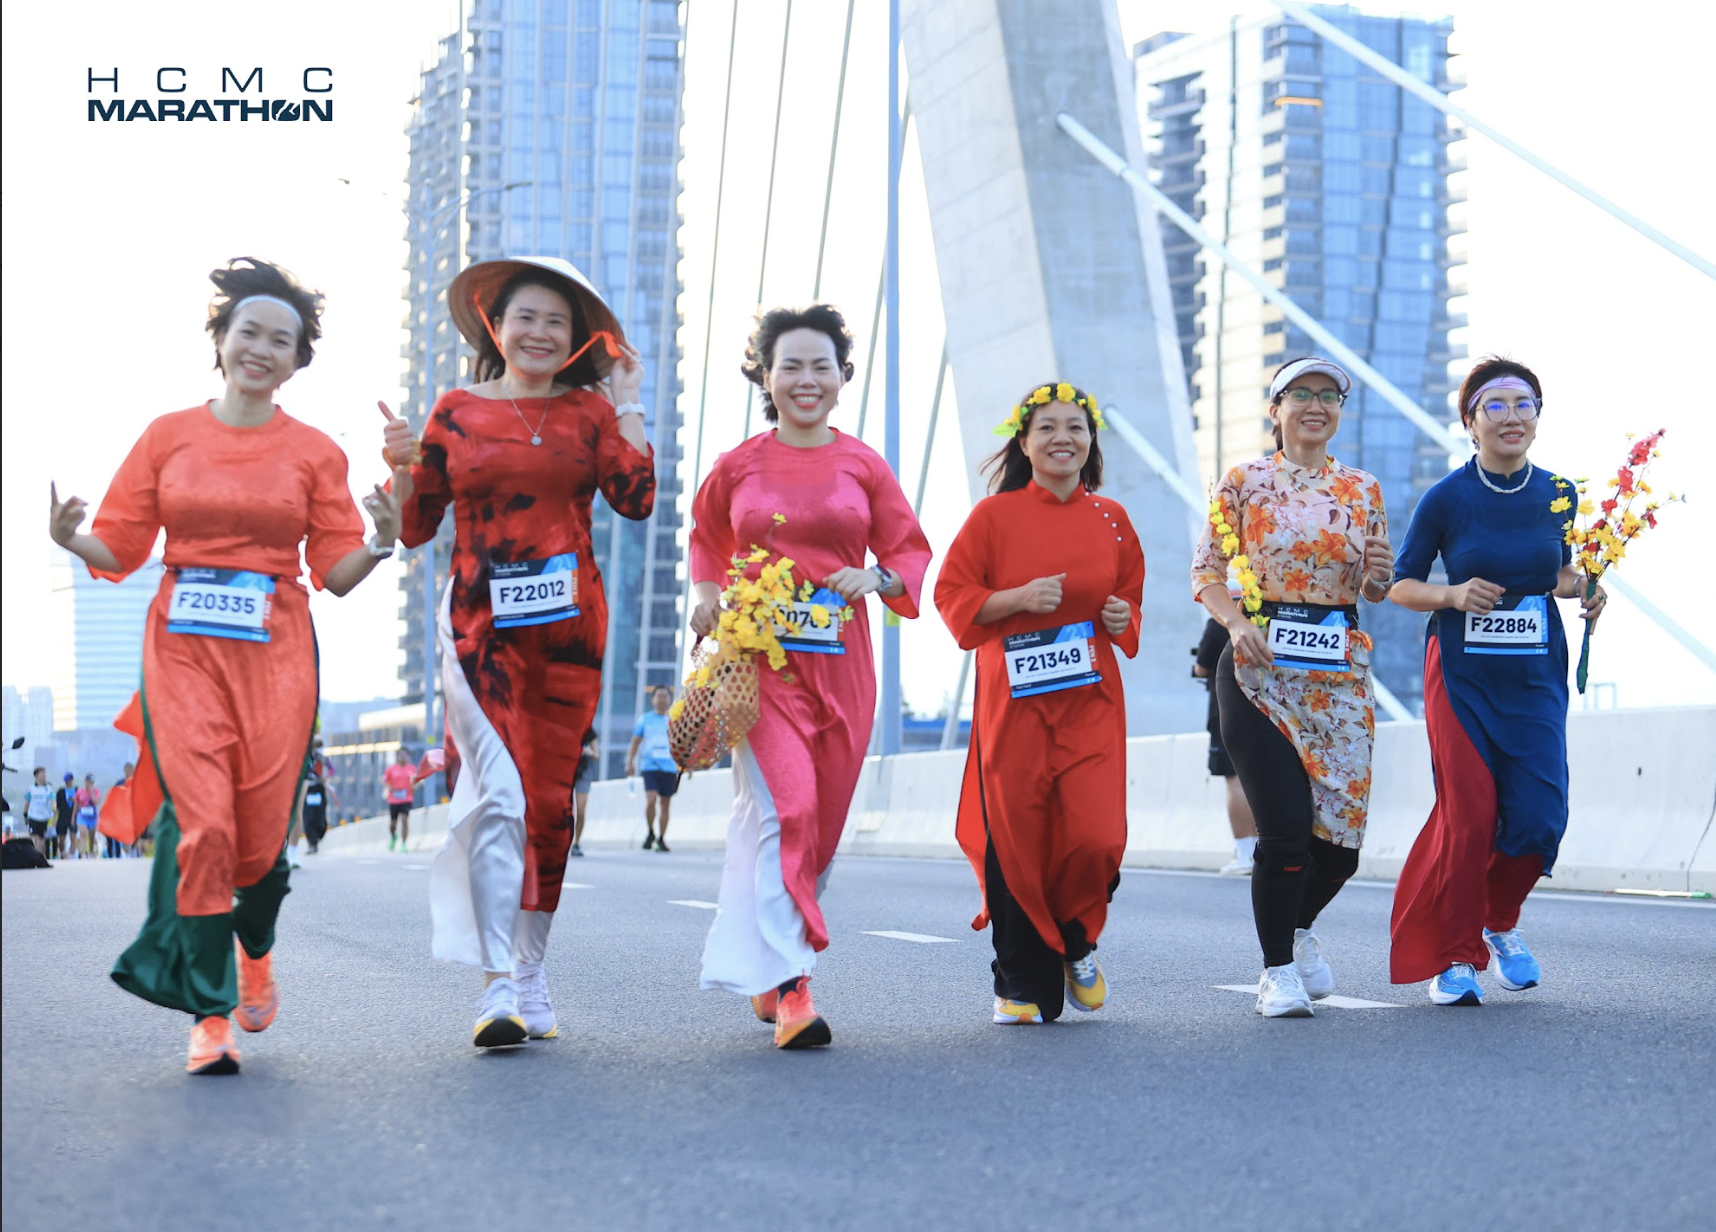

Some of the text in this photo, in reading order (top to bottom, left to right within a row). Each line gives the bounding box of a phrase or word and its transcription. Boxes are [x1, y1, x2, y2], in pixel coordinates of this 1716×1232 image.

[500, 579, 565, 604] F22012
[178, 592, 255, 614] F20335
[1471, 616, 1537, 633] F22884
[1275, 627, 1340, 649] F21242
[1015, 648, 1081, 674] F21349
